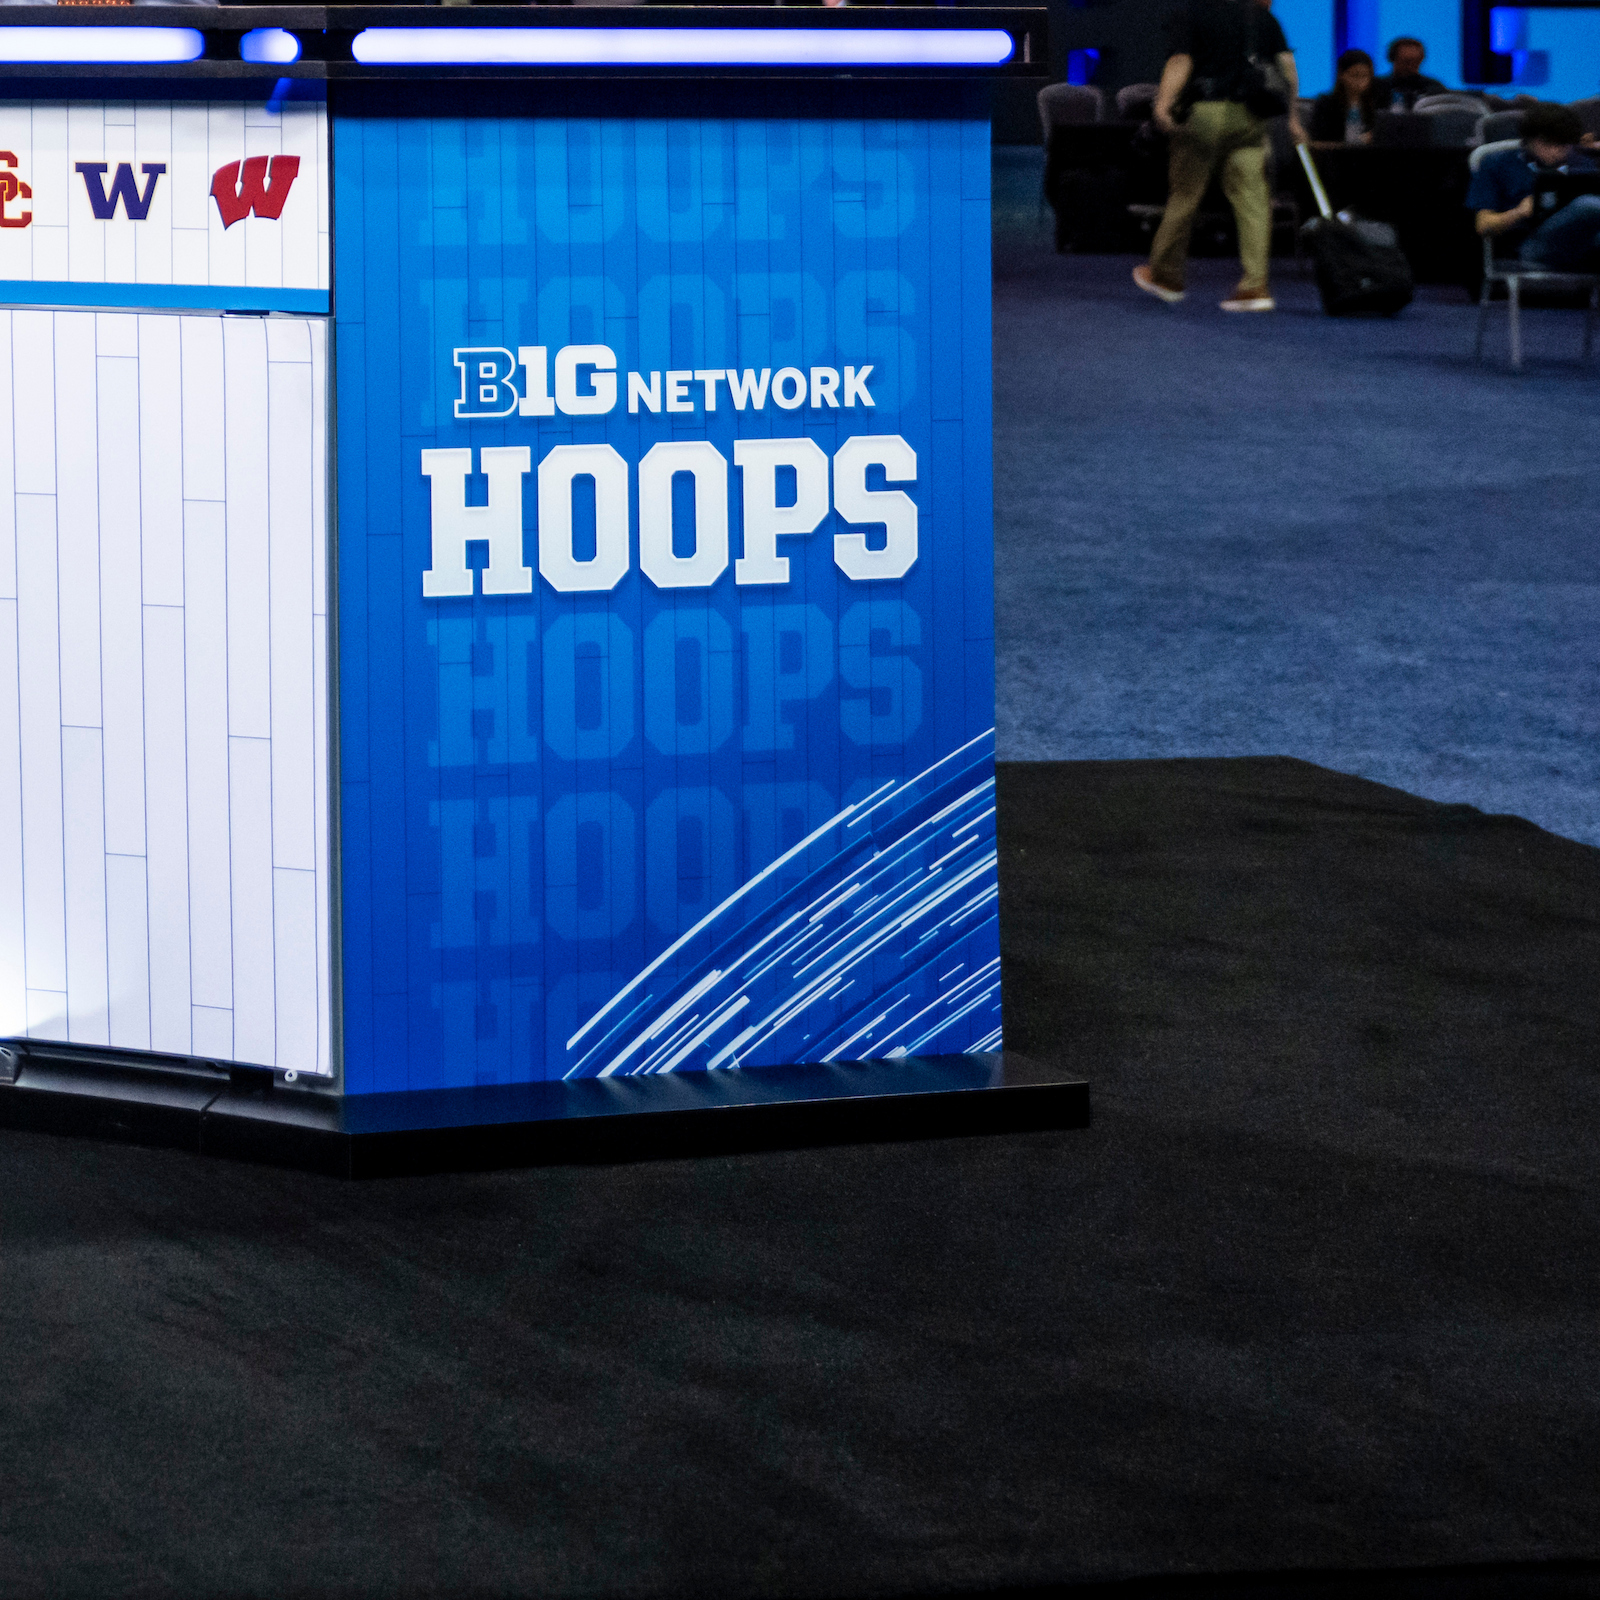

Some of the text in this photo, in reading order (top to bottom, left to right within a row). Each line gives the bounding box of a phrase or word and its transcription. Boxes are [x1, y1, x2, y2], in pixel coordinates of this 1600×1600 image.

[75, 161, 167, 221] W
[209, 155, 300, 230] W
[453, 344, 876, 418] B1G NETWORK
[421, 434, 919, 598] HOOPS
[426, 599, 924, 768] HOOPS
